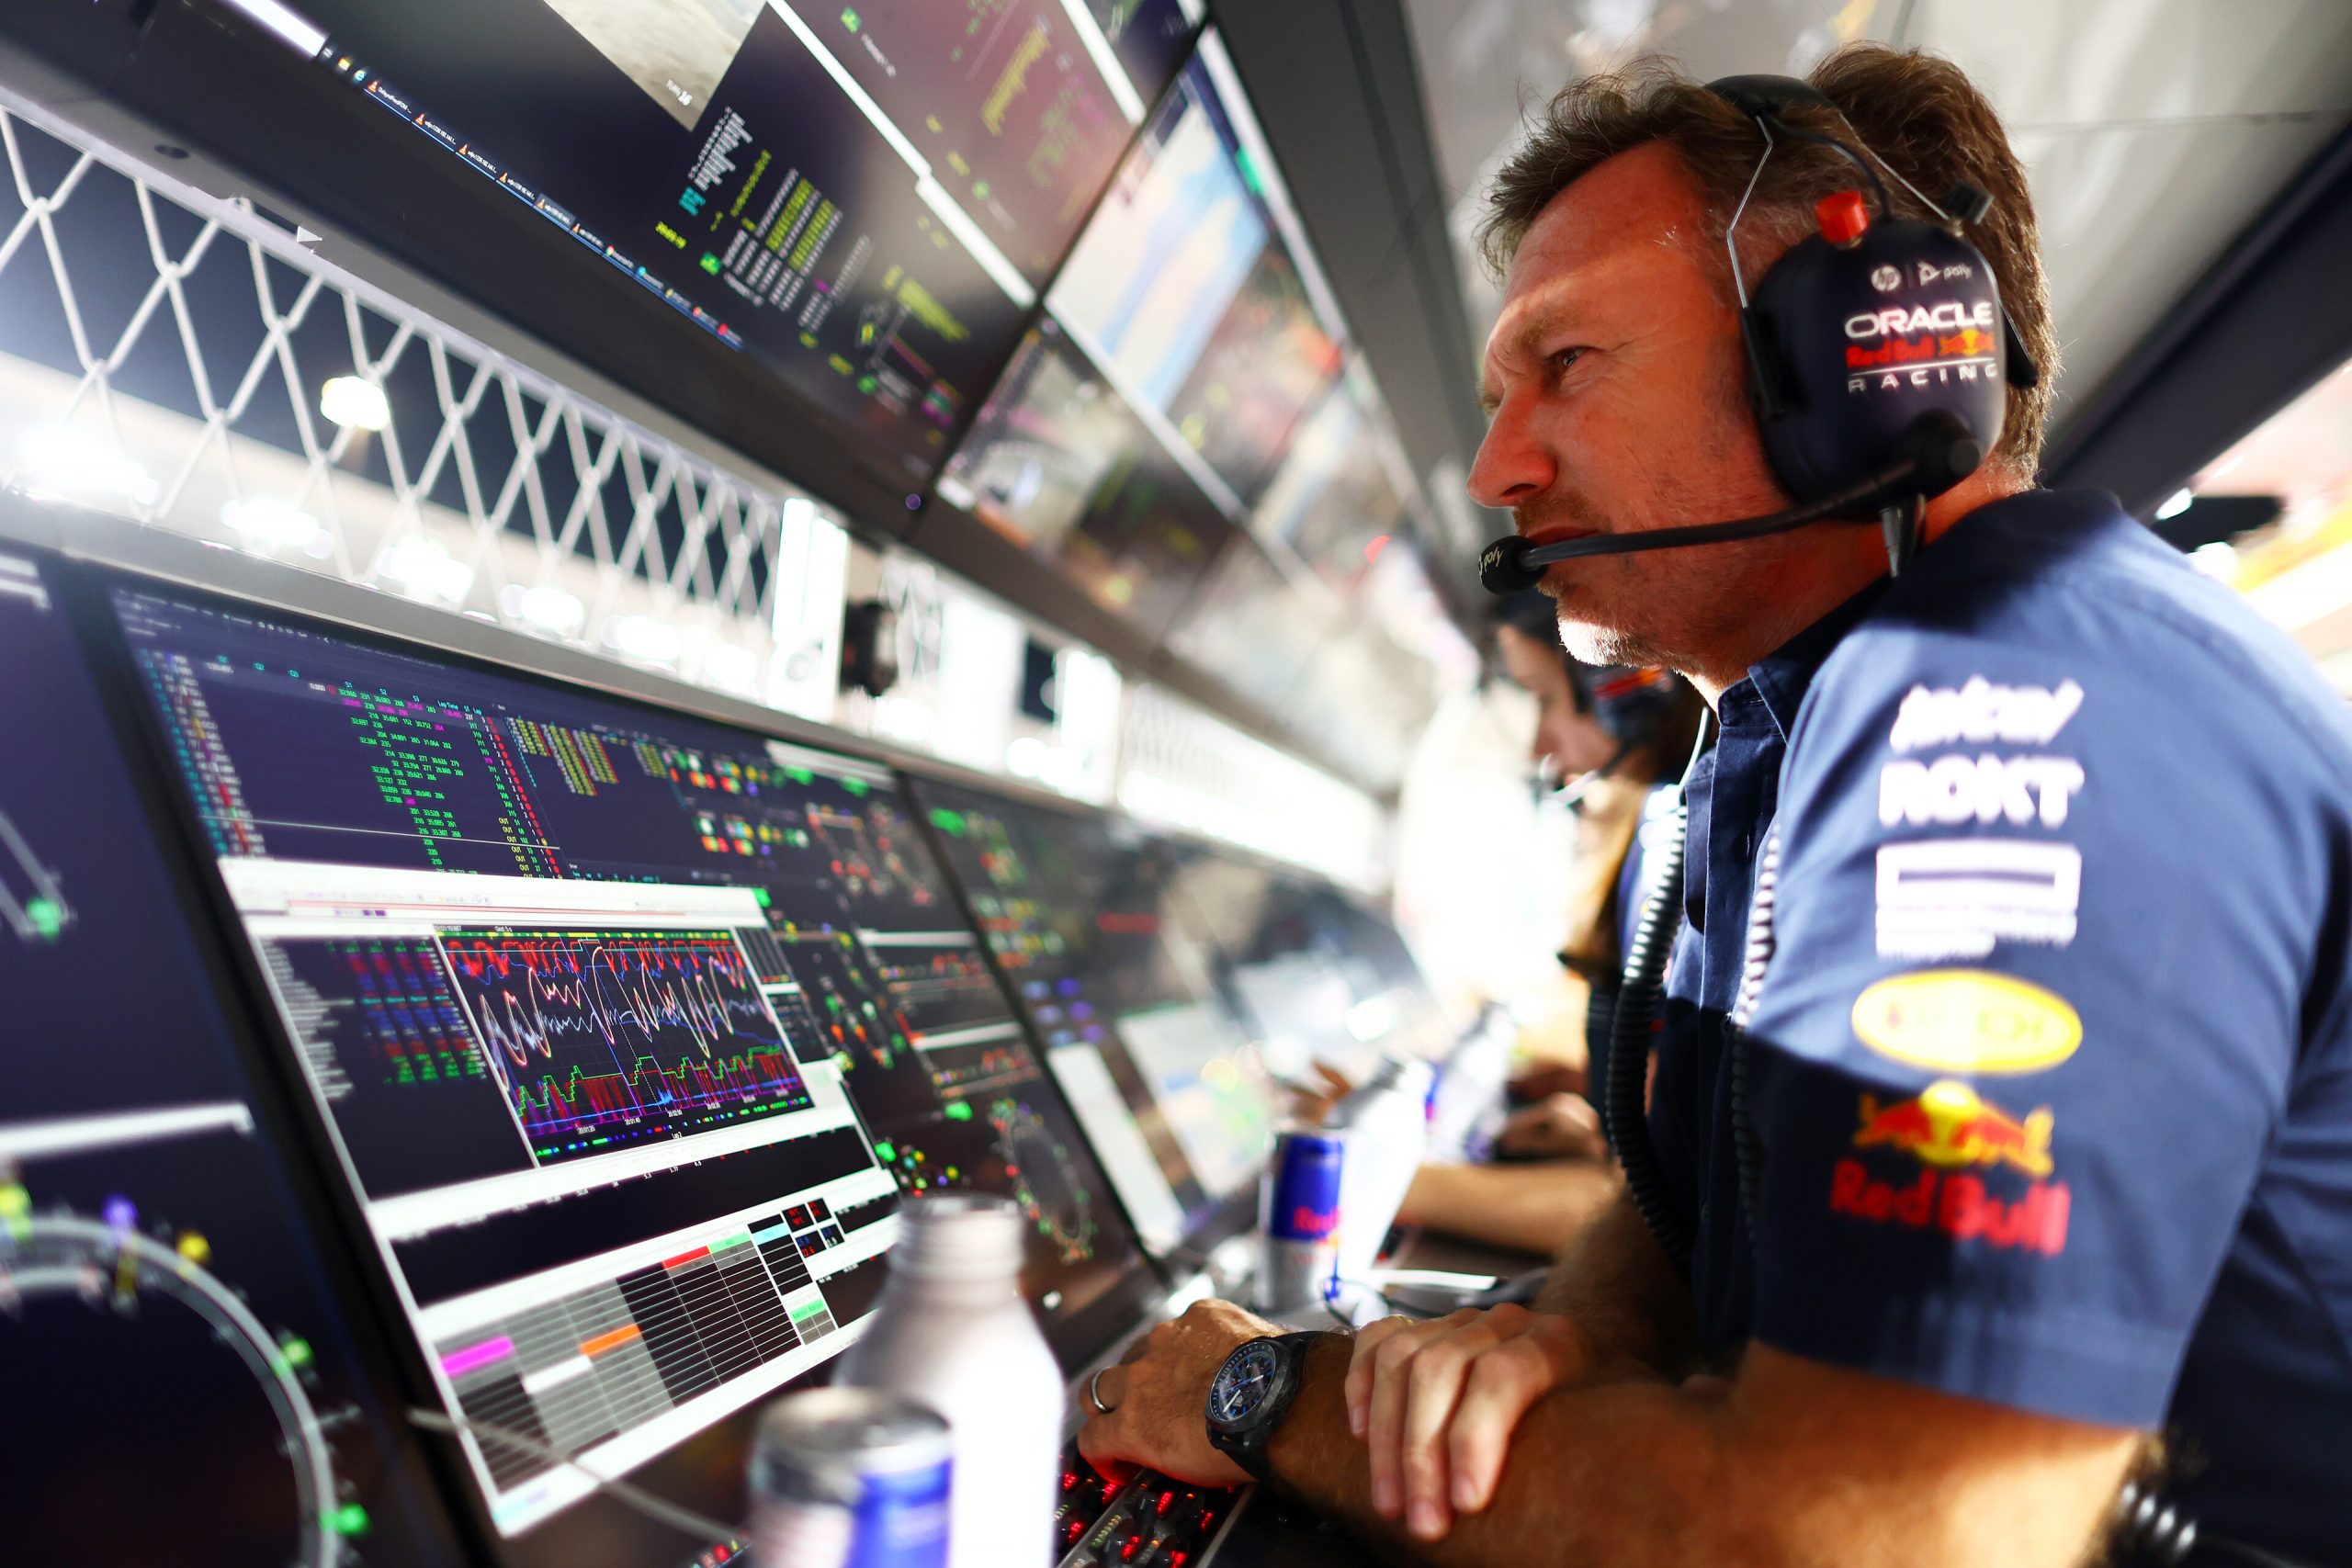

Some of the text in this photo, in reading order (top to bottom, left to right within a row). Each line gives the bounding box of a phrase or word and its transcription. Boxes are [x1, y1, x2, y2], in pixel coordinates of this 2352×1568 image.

[1943, 263, 1973, 280] poly
[1844, 301, 1995, 339] ORACLE
[1847, 363, 1999, 393] RACING
[1483, 546, 1504, 572] poly
[1878, 752, 2086, 829] ROKT
[1829, 1158, 2073, 1259] Red Bull
